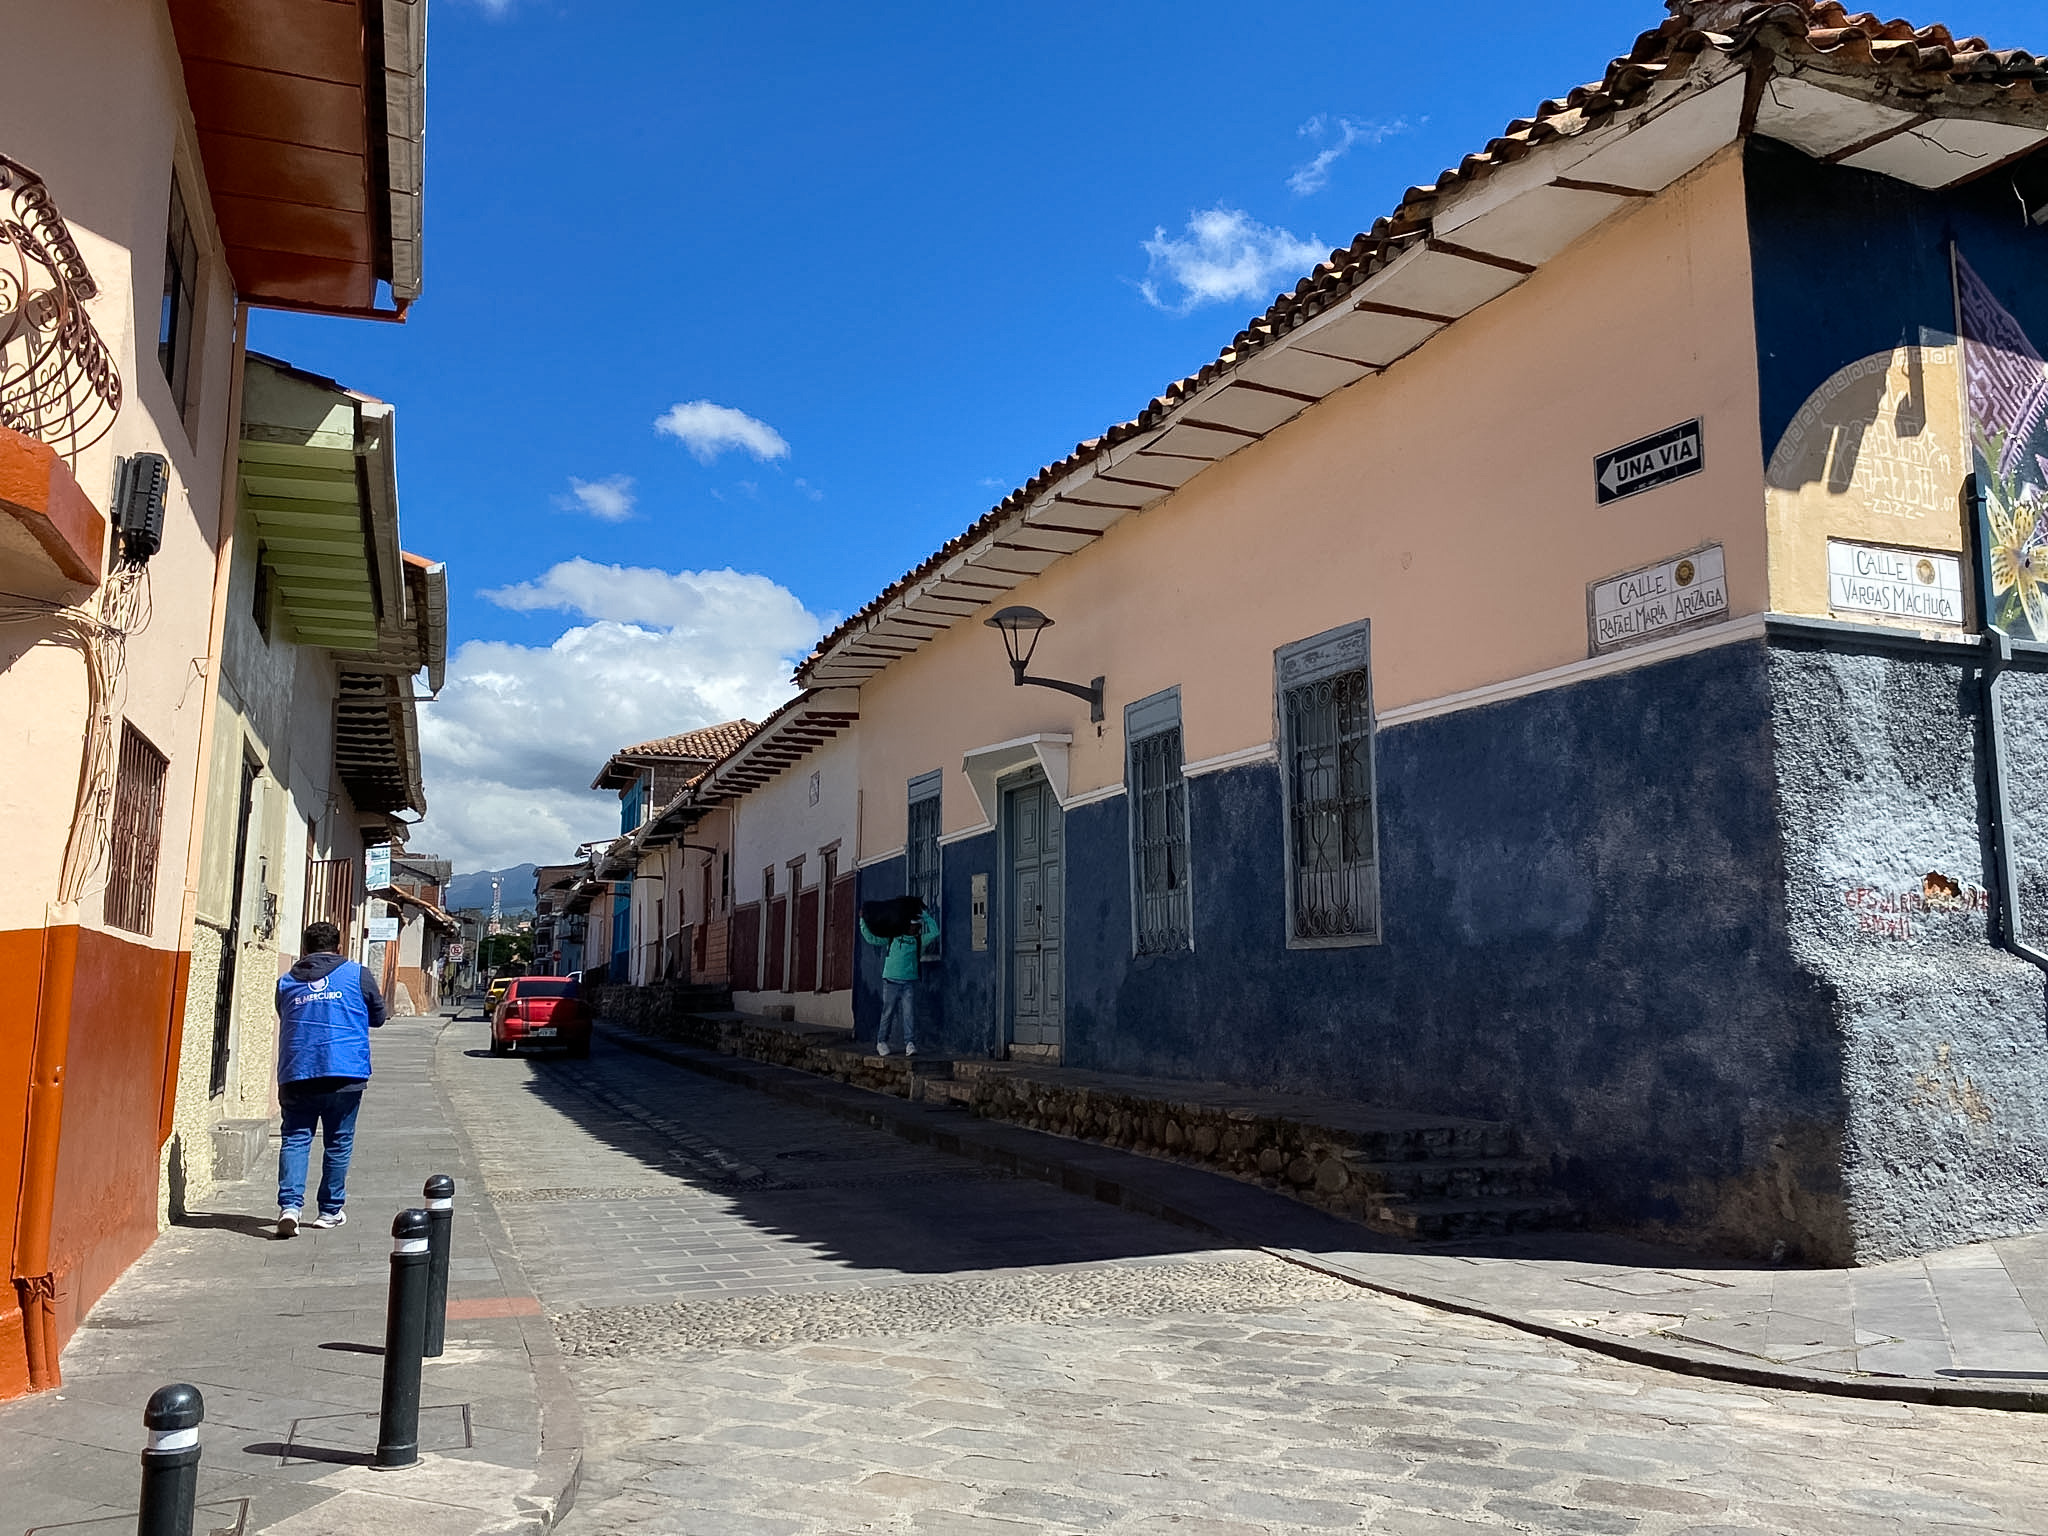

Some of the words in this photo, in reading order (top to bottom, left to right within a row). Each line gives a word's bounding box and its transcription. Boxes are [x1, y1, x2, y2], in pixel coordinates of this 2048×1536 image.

[1616, 453, 1655, 481] UNA
[1659, 439, 1693, 465] VIA
[1857, 550, 1908, 581] CALLE
[1618, 575, 1667, 605] CALLE
[1841, 576, 1890, 610] VARGAS
[1893, 585, 1953, 617] MACHUCA
[1598, 610, 1637, 641] RAFAEL
[303, 991, 343, 1004] MERCURIO
